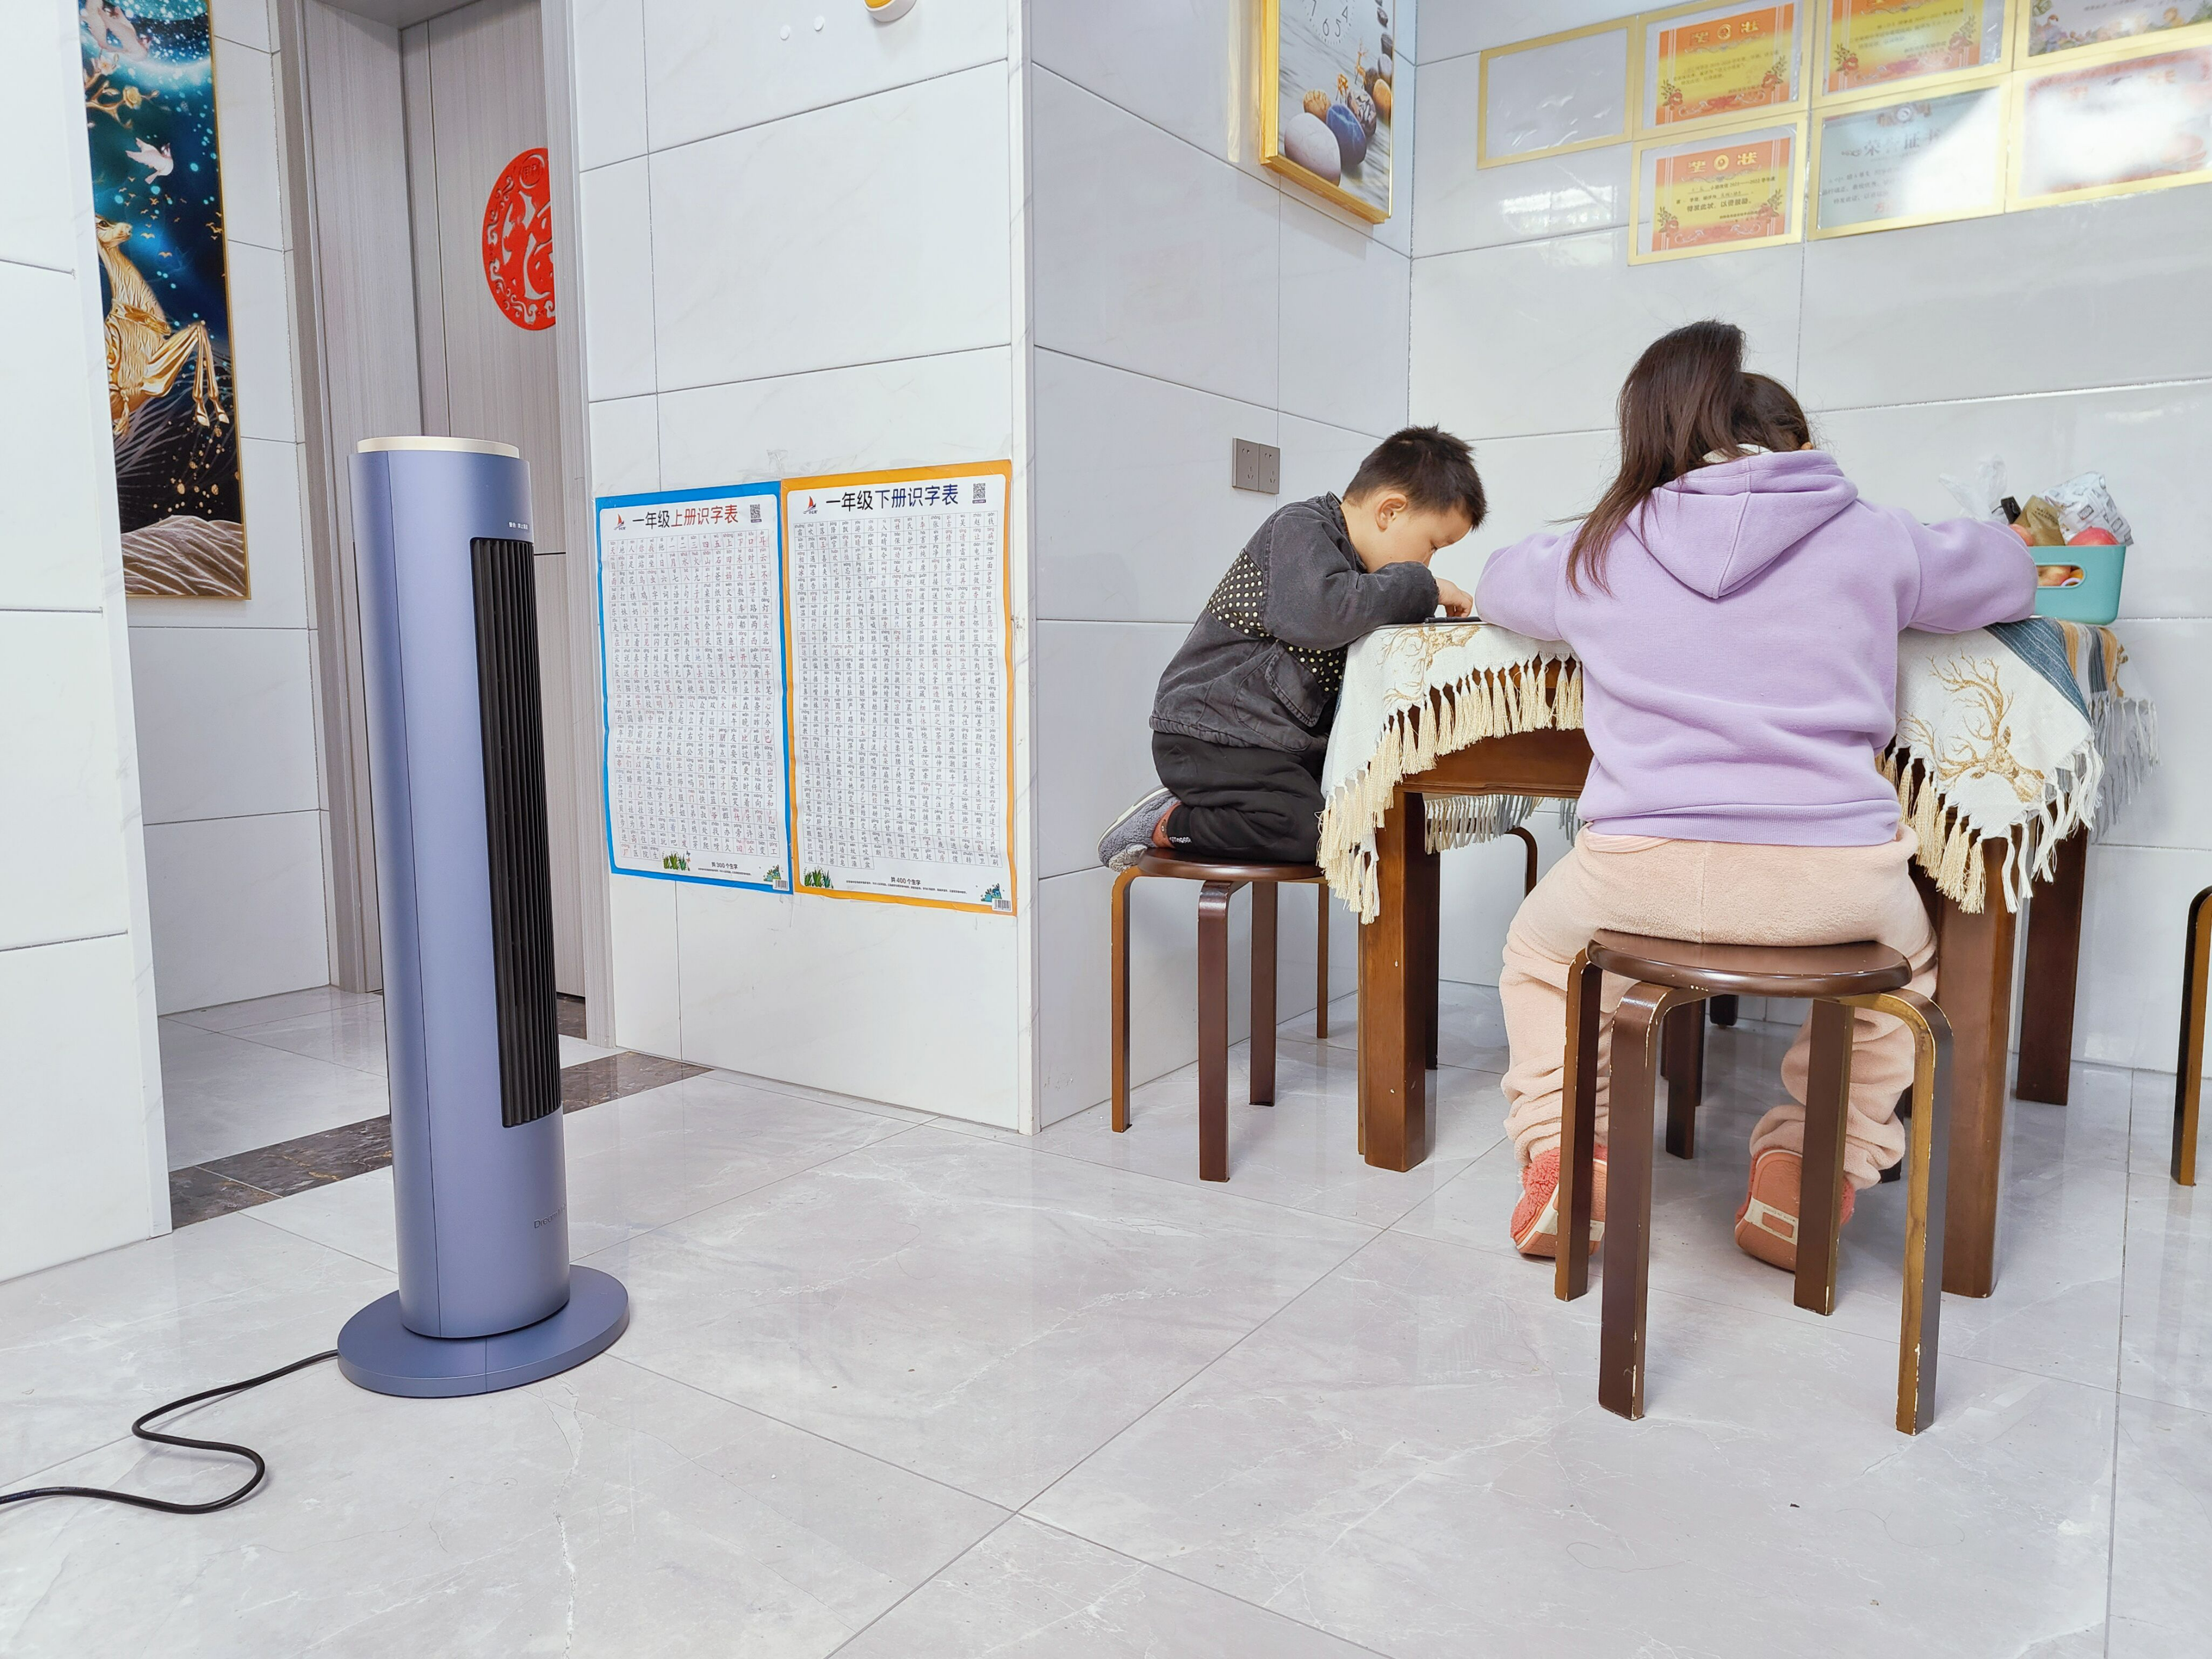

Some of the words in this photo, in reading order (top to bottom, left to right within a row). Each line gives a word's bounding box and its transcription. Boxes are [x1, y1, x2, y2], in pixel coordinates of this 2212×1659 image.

[1322, 18, 1329, 36] 6
[1335, 18, 1341, 37] 5
[826, 483, 958, 512] 一年级下册识字表
[632, 504, 739, 530] 一年级上册识字表
